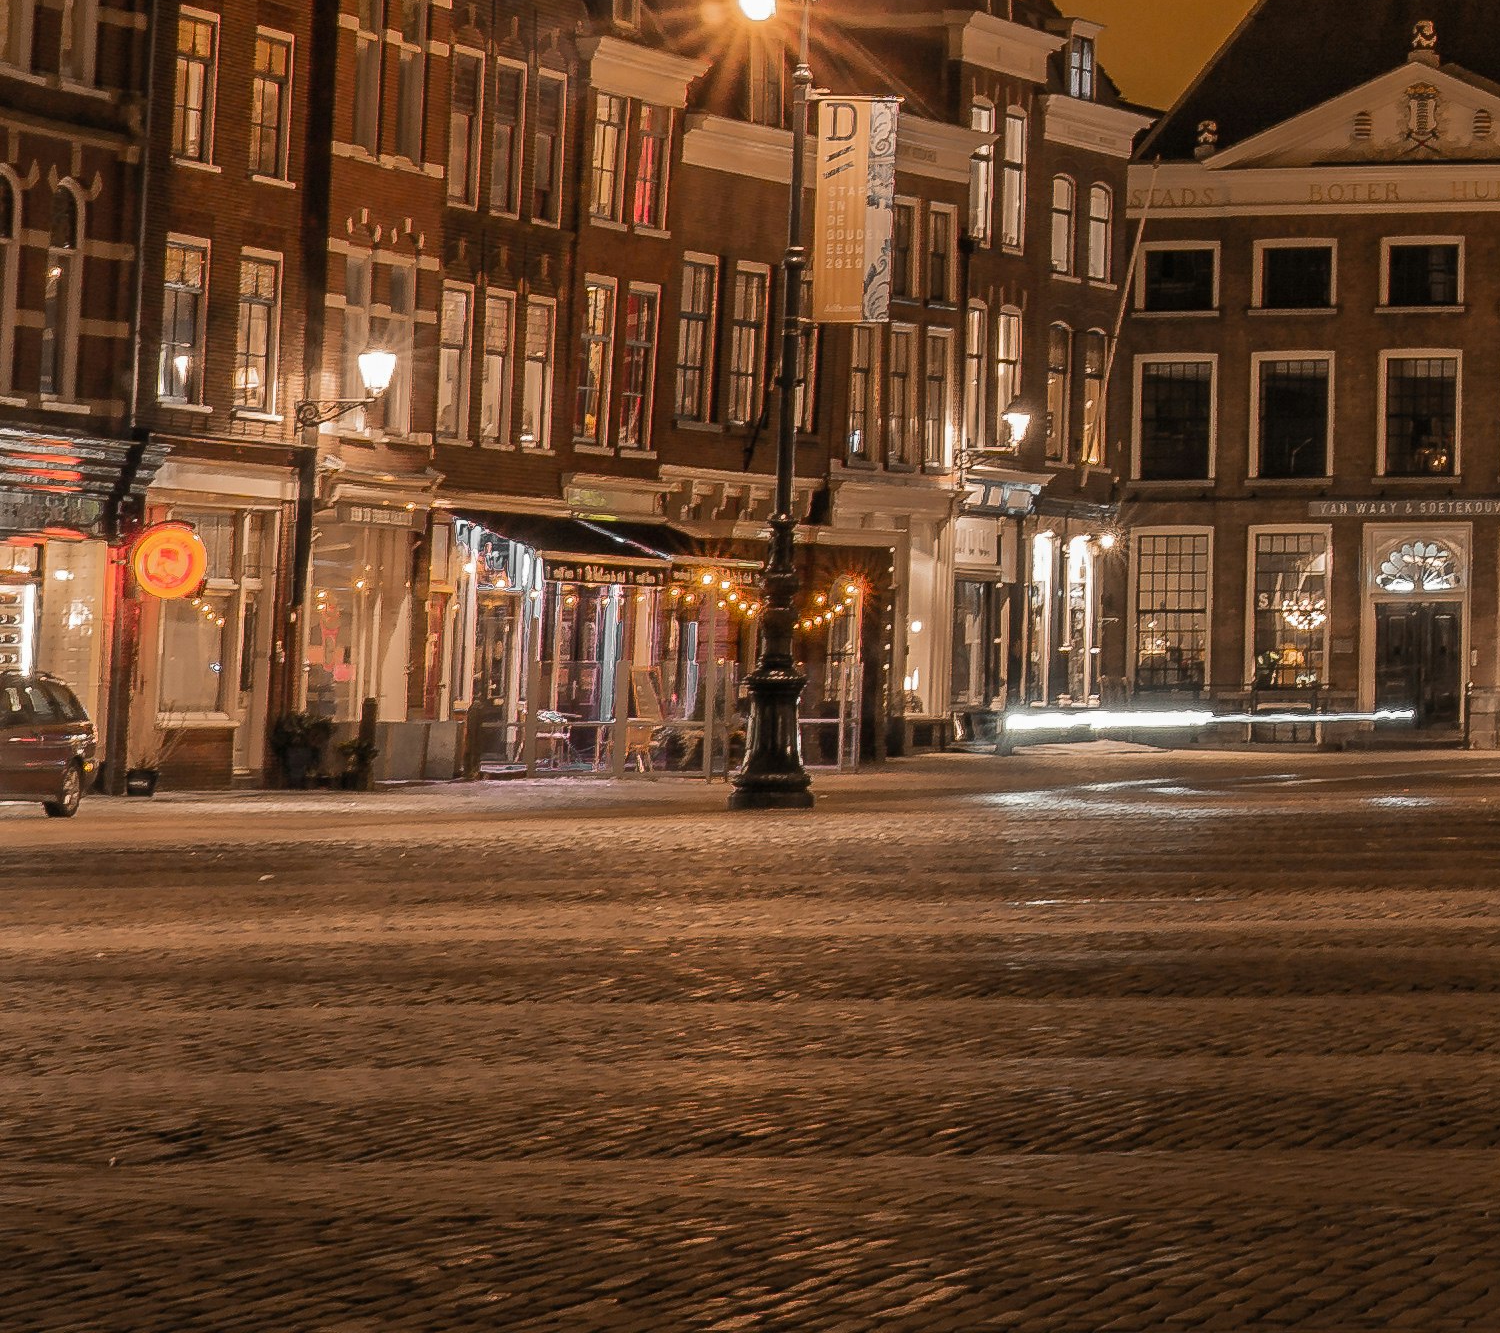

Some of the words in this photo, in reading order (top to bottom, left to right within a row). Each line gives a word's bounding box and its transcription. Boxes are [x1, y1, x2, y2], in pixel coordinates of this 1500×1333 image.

[825, 102, 858, 142] D
[1130, 187, 1214, 207] STADS
[1308, 181, 1399, 202] BOTER
[828, 200, 846, 212] IN
[827, 214, 845, 226] DE
[826, 258, 863, 269] 2019
[1320, 501, 1348, 514] VAN
[1356, 501, 1397, 514] WAAY
